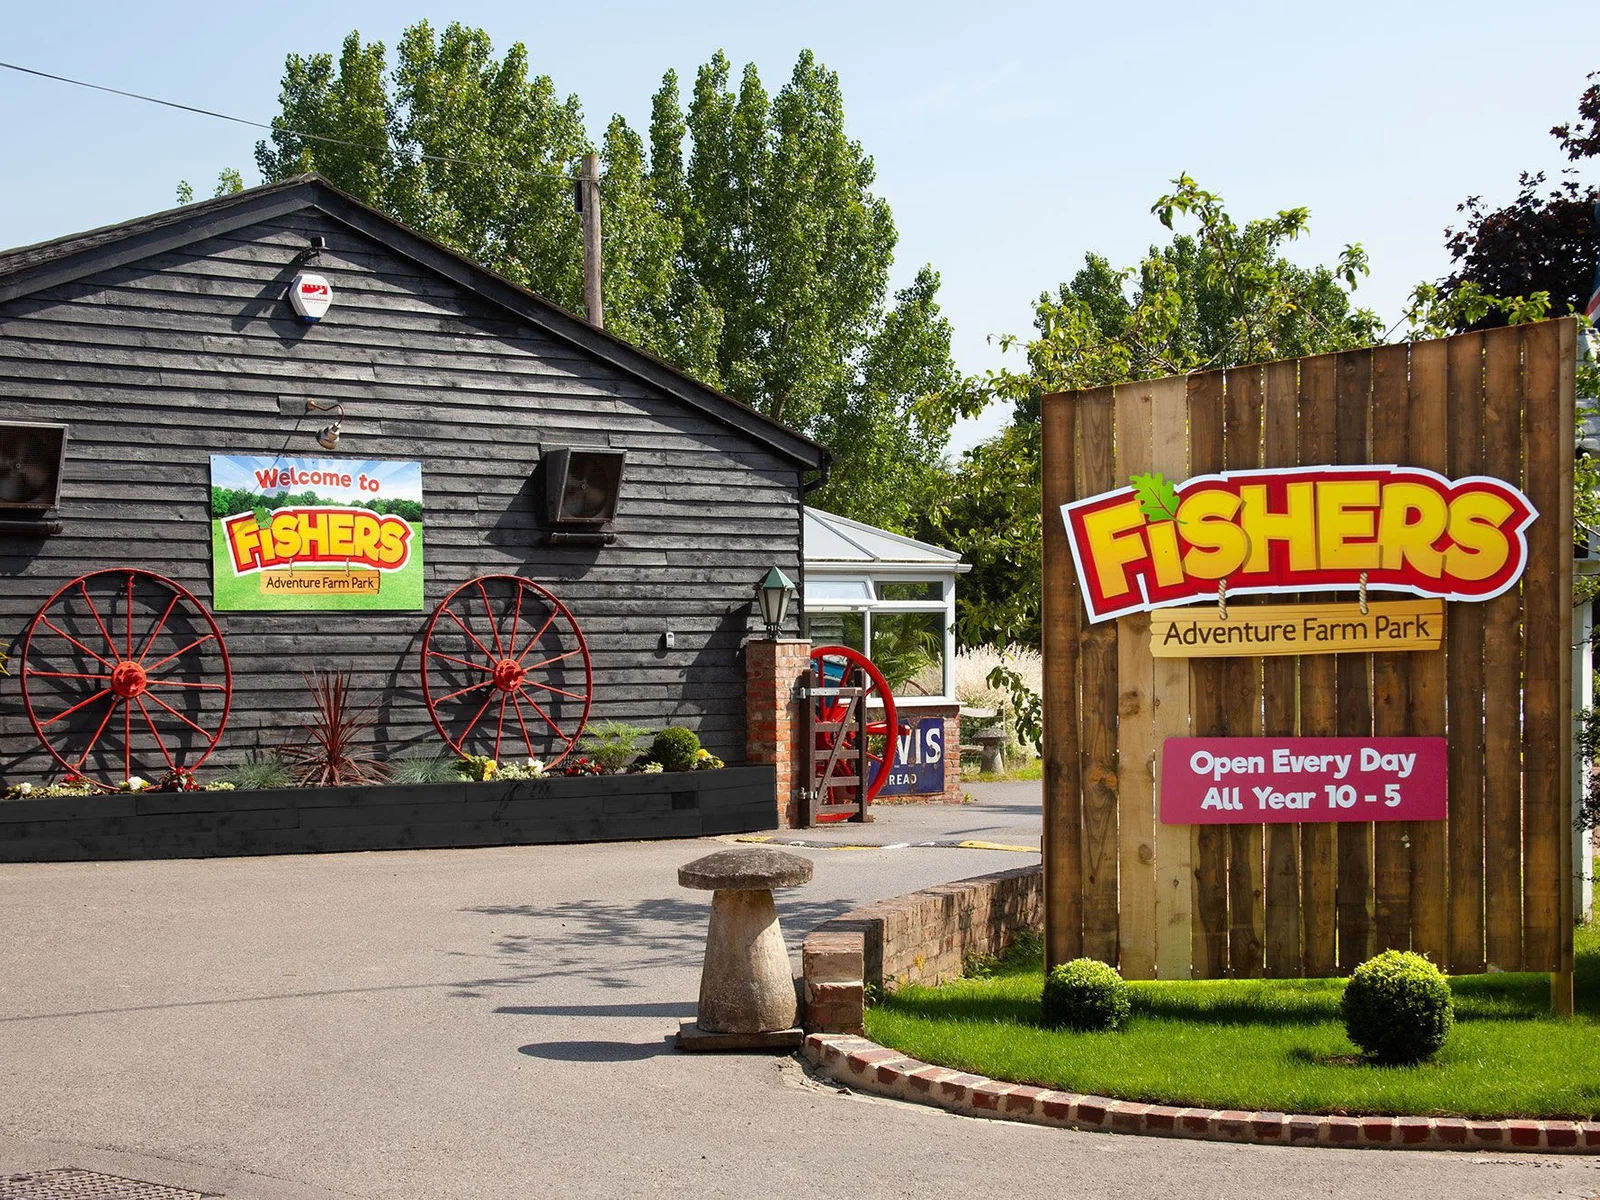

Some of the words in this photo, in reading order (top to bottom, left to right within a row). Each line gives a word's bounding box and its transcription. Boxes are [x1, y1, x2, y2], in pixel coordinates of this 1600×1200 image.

[255, 467, 351, 489] Welcome
[359, 474, 380, 493] to
[266, 576, 321, 588] Adventure
[322, 577, 349, 588] Farm
[351, 577, 374, 588] Park
[1163, 619, 1296, 646] Adventure
[1303, 617, 1368, 642] Farm
[1375, 614, 1430, 639] Park
[896, 727, 942, 766] VIS
[1189, 750, 1265, 780] Open
[1272, 748, 1352, 779] Every
[1360, 748, 1417, 779] Day
[888, 773, 917, 786] READ
[1201, 786, 1243, 811] All
[1252, 785, 1316, 810] Year
[1325, 785, 1357, 809] 10
[1384, 784, 1401, 808] 5
